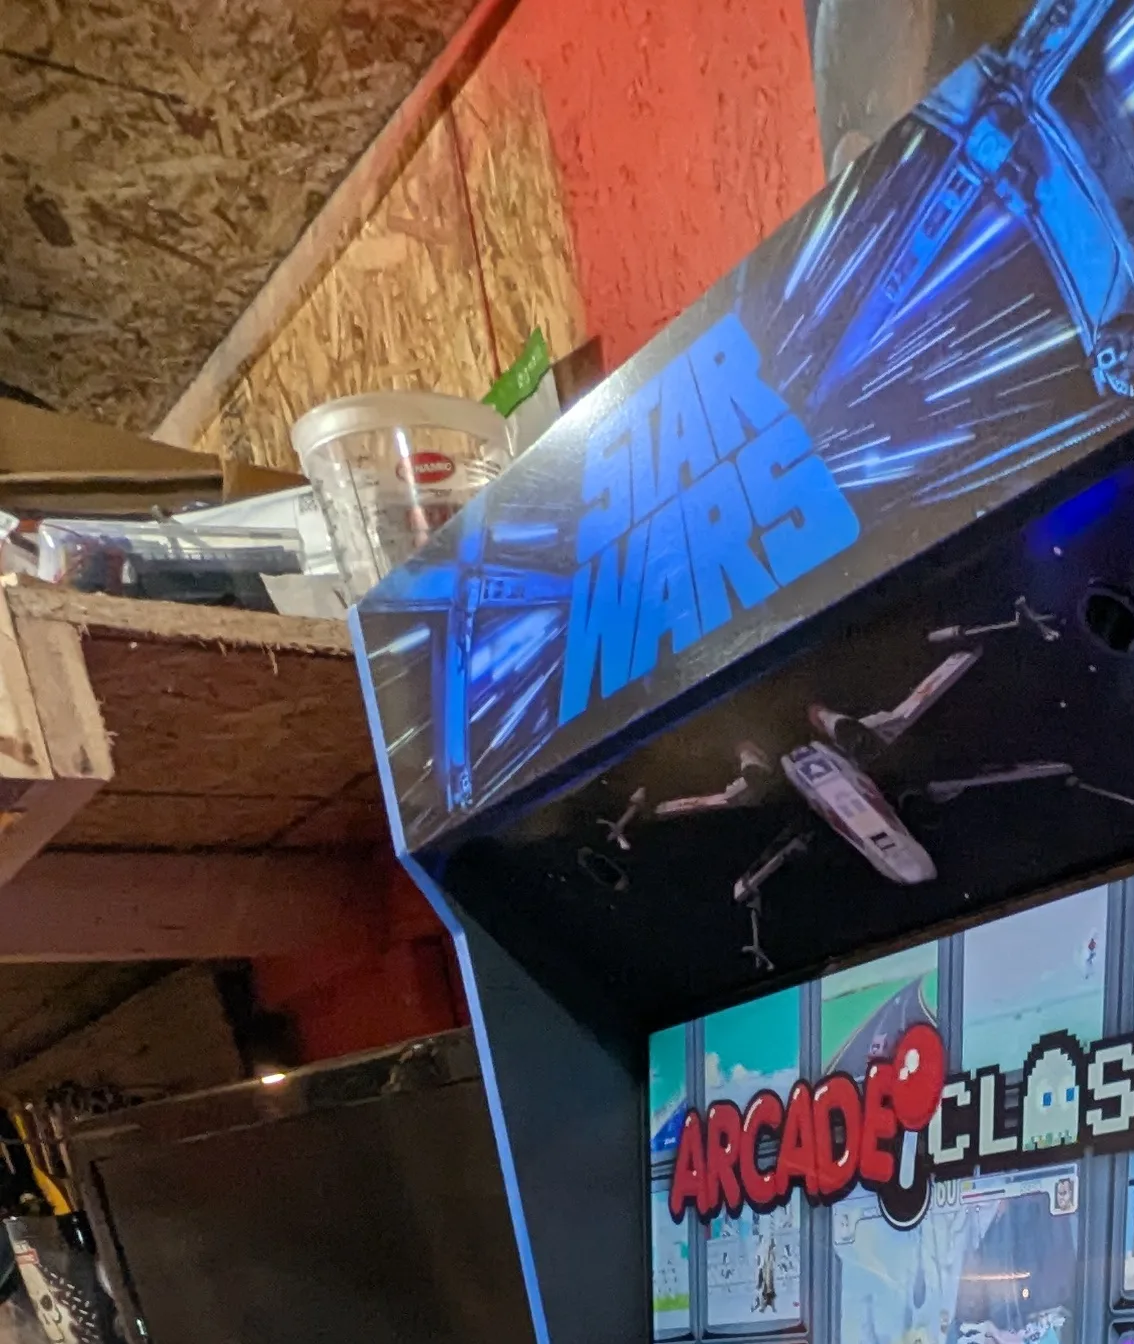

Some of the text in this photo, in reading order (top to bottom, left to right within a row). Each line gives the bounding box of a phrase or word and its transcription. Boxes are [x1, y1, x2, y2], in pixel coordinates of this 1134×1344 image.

[577, 312, 790, 565] STAR
[558, 414, 861, 728] WARS
[670, 1057, 898, 1217] ARCADE
